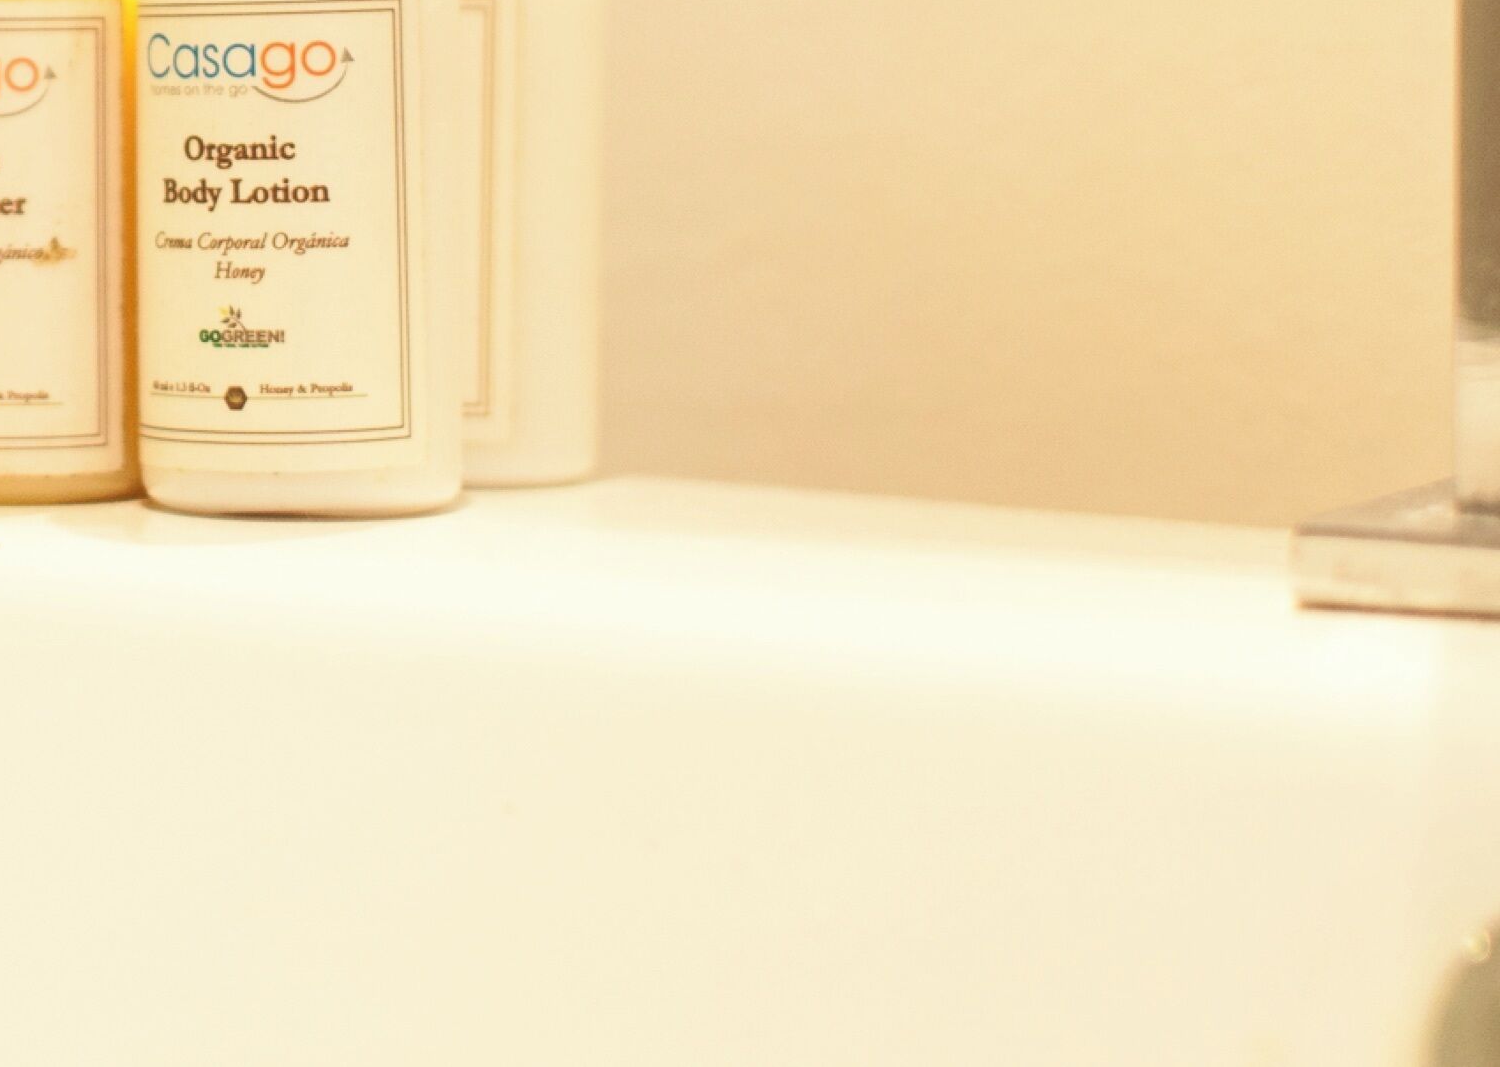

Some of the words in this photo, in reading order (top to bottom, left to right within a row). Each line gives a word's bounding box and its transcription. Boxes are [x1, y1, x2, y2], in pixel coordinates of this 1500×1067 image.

[148, 33, 337, 90] Casago
[228, 86, 247, 98] go
[184, 135, 296, 169] Organic
[163, 178, 222, 212] Body
[230, 178, 330, 204] Lotion
[155, 231, 192, 249] Crema
[197, 232, 267, 256] Corporal
[271, 232, 350, 256] Orgánica
[214, 261, 266, 284] Honey
[199, 329, 286, 343] GOGREEN!
